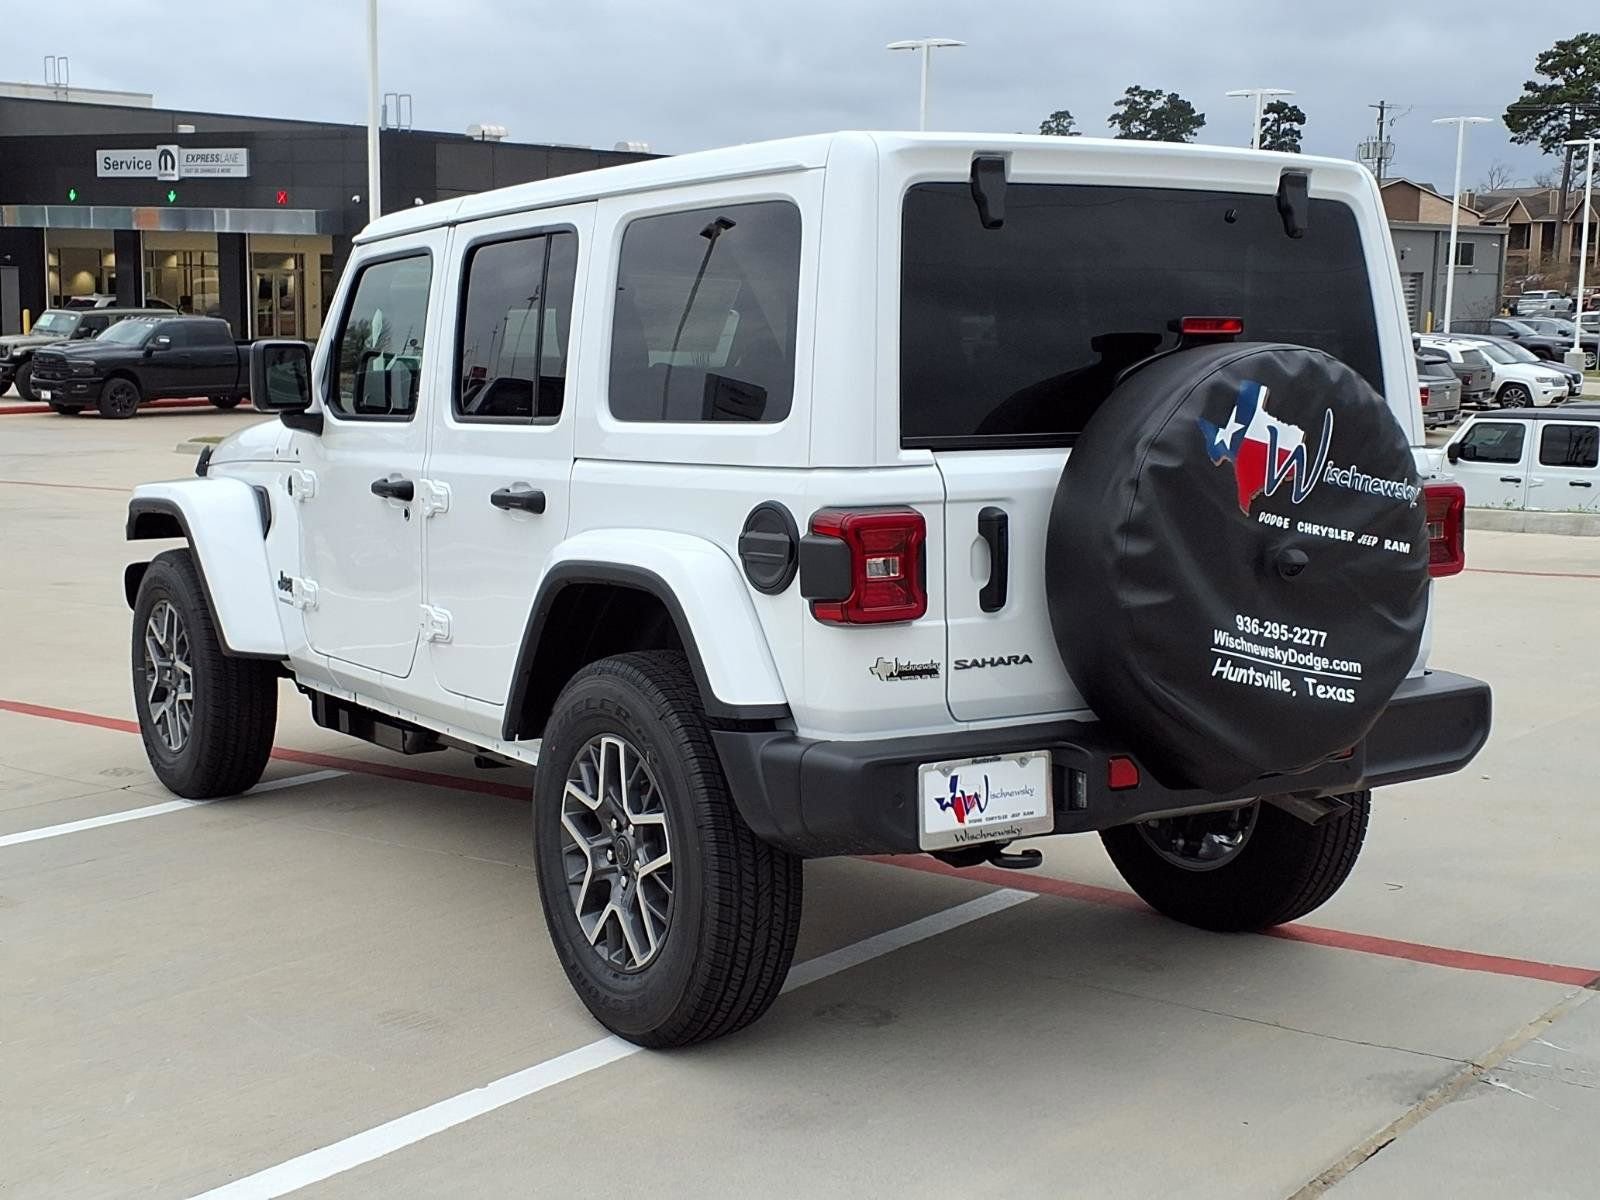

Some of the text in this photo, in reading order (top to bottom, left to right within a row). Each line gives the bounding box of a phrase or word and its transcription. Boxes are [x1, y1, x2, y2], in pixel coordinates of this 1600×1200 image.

[103, 156, 152, 171] Service
[1264, 408, 1421, 509] Wischnewsky
[1258, 511, 1411, 554] DODGE CHRYSLER JEEP RAM
[1213, 628, 1363, 674] WischnewskyDodge.com
[1235, 614, 1328, 648] 936-295-2277
[954, 654, 1033, 670] SAHARA
[1211, 657, 1356, 703] Huntsville, Texas
[959, 774, 1036, 815] Wischnewsky
[954, 825, 1024, 843] Wischnewsky
